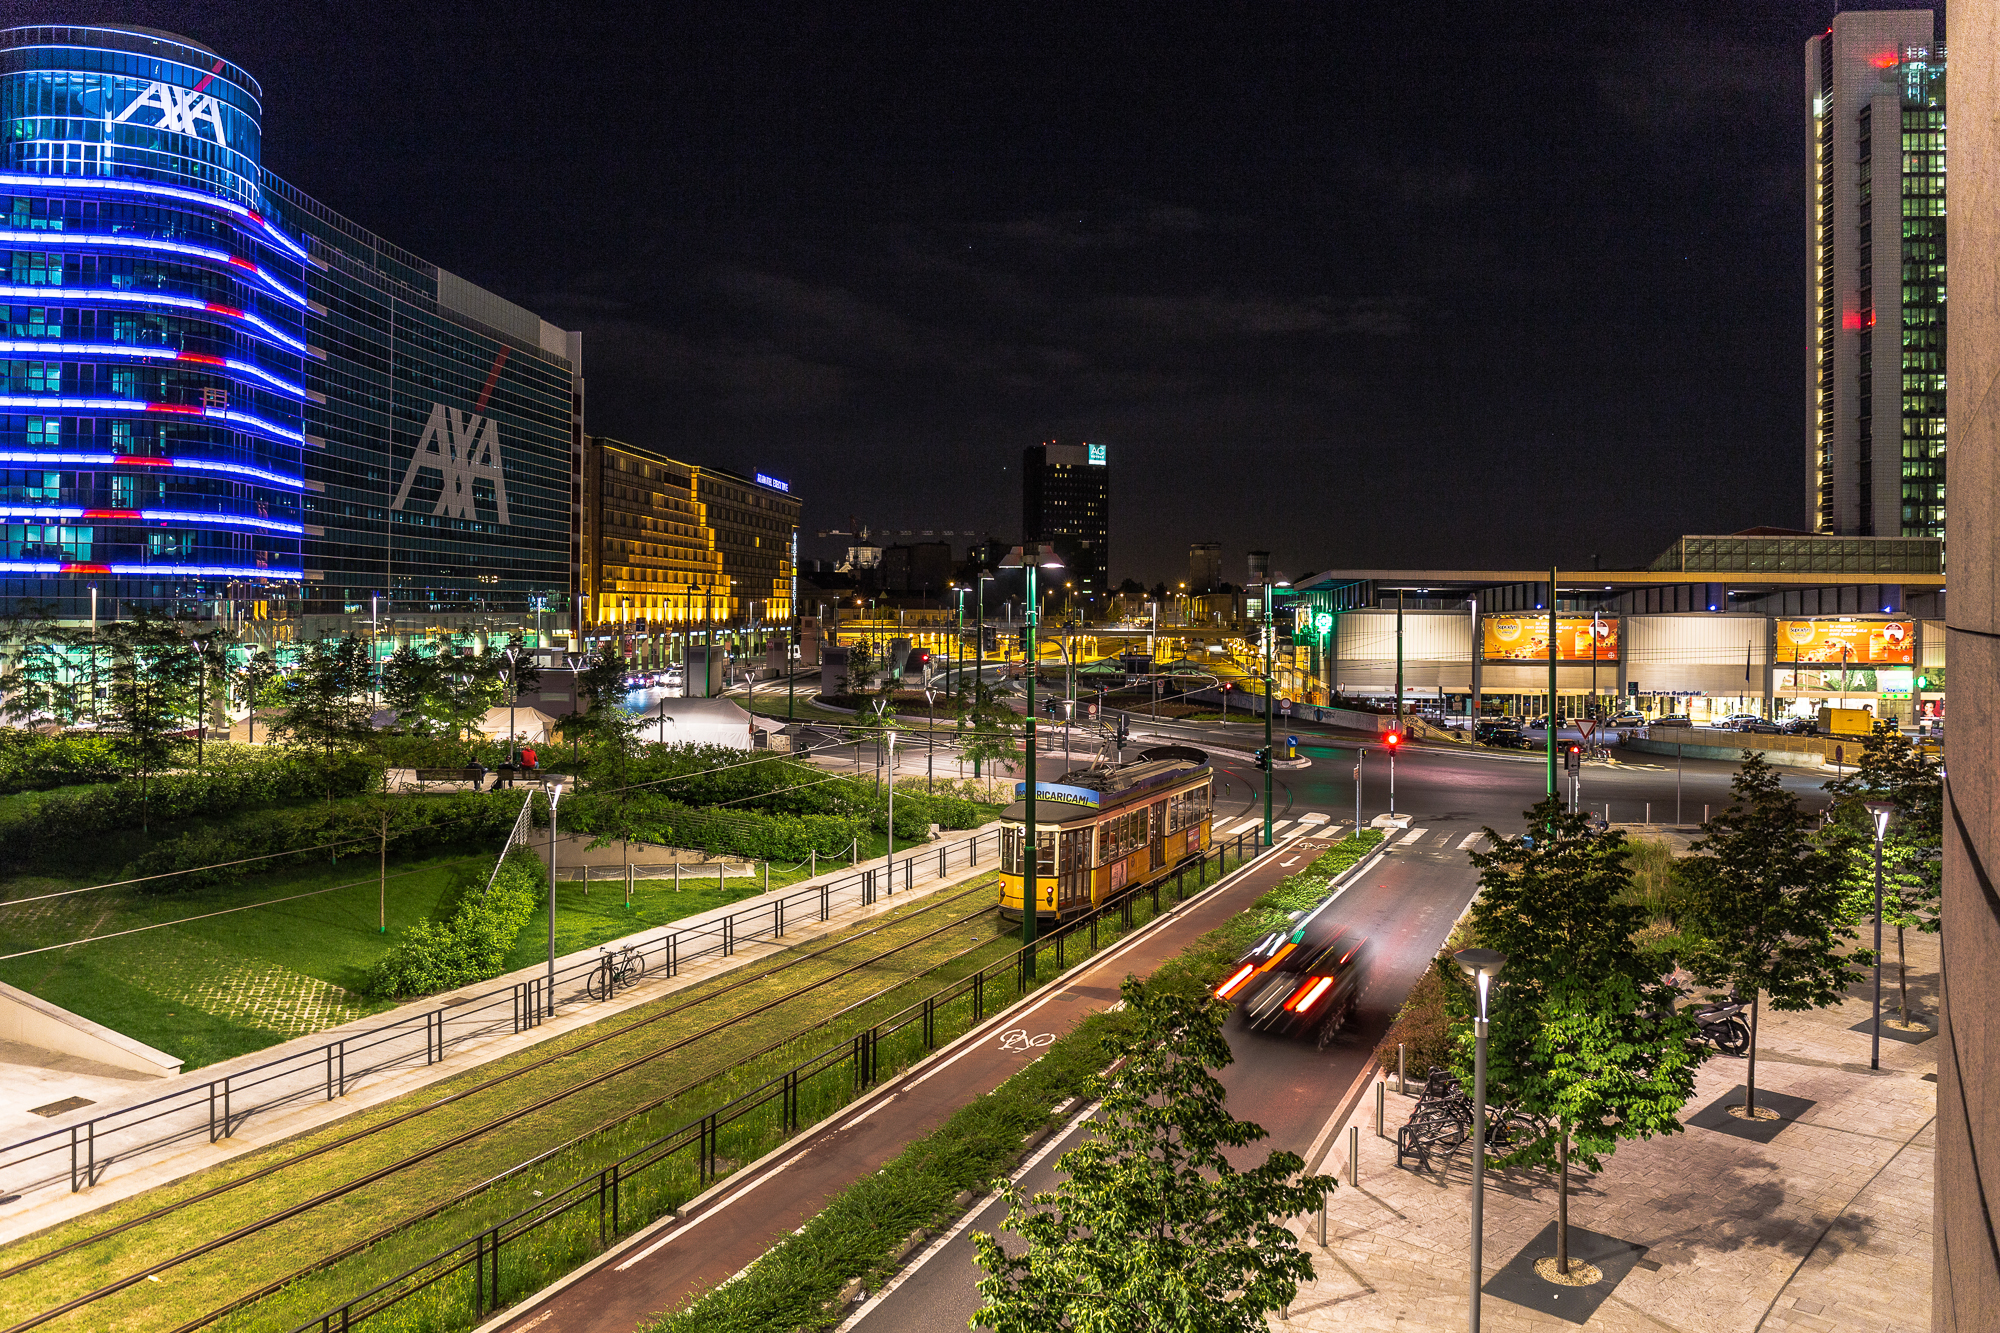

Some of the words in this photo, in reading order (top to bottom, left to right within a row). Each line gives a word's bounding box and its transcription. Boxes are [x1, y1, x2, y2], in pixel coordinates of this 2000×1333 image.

[114, 82, 227, 147] AXA
[1091, 447, 1104, 455] AC
[391, 402, 511, 525] AXA
[1036, 790, 1089, 806] RICARICAMI
[1018, 826, 1026, 837] 3
